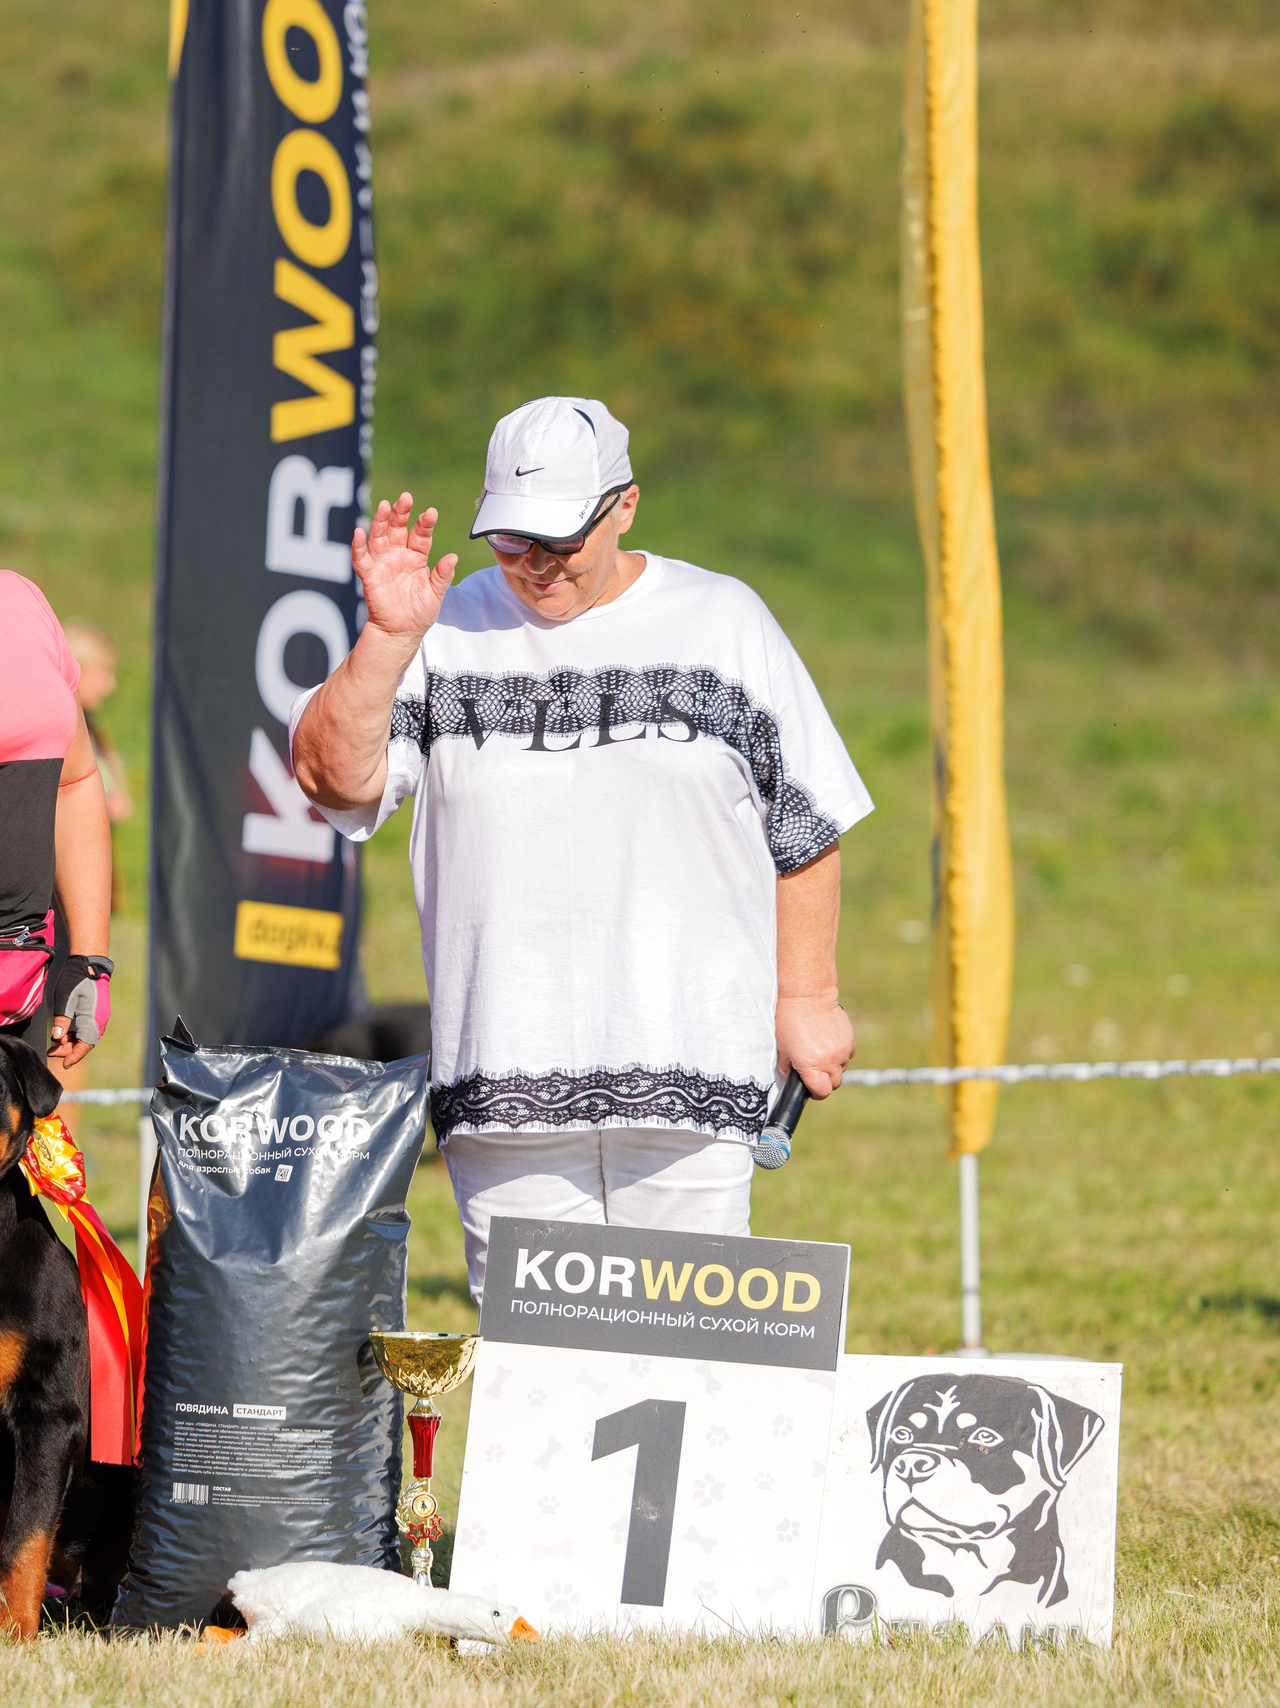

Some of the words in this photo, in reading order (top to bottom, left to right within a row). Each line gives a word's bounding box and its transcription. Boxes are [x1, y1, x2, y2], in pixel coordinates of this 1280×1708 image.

[179, 1113, 372, 1145] KORWOOD
[178, 1147, 291, 1160] ПОЛНОРАЦОННЫЙ
[514, 1247, 822, 1313] KORWOOD
[510, 1299, 695, 1329] ПОЛНОРАЦИОННЫЙ
[699, 1315, 759, 1334] СУХОЙ
[763, 1321, 816, 1339] КОРМ
[175, 1403, 229, 1415] ГОВЯДИНА
[236, 1406, 284, 1417] СТАНДАРТ
[591, 1398, 687, 1607] 1
